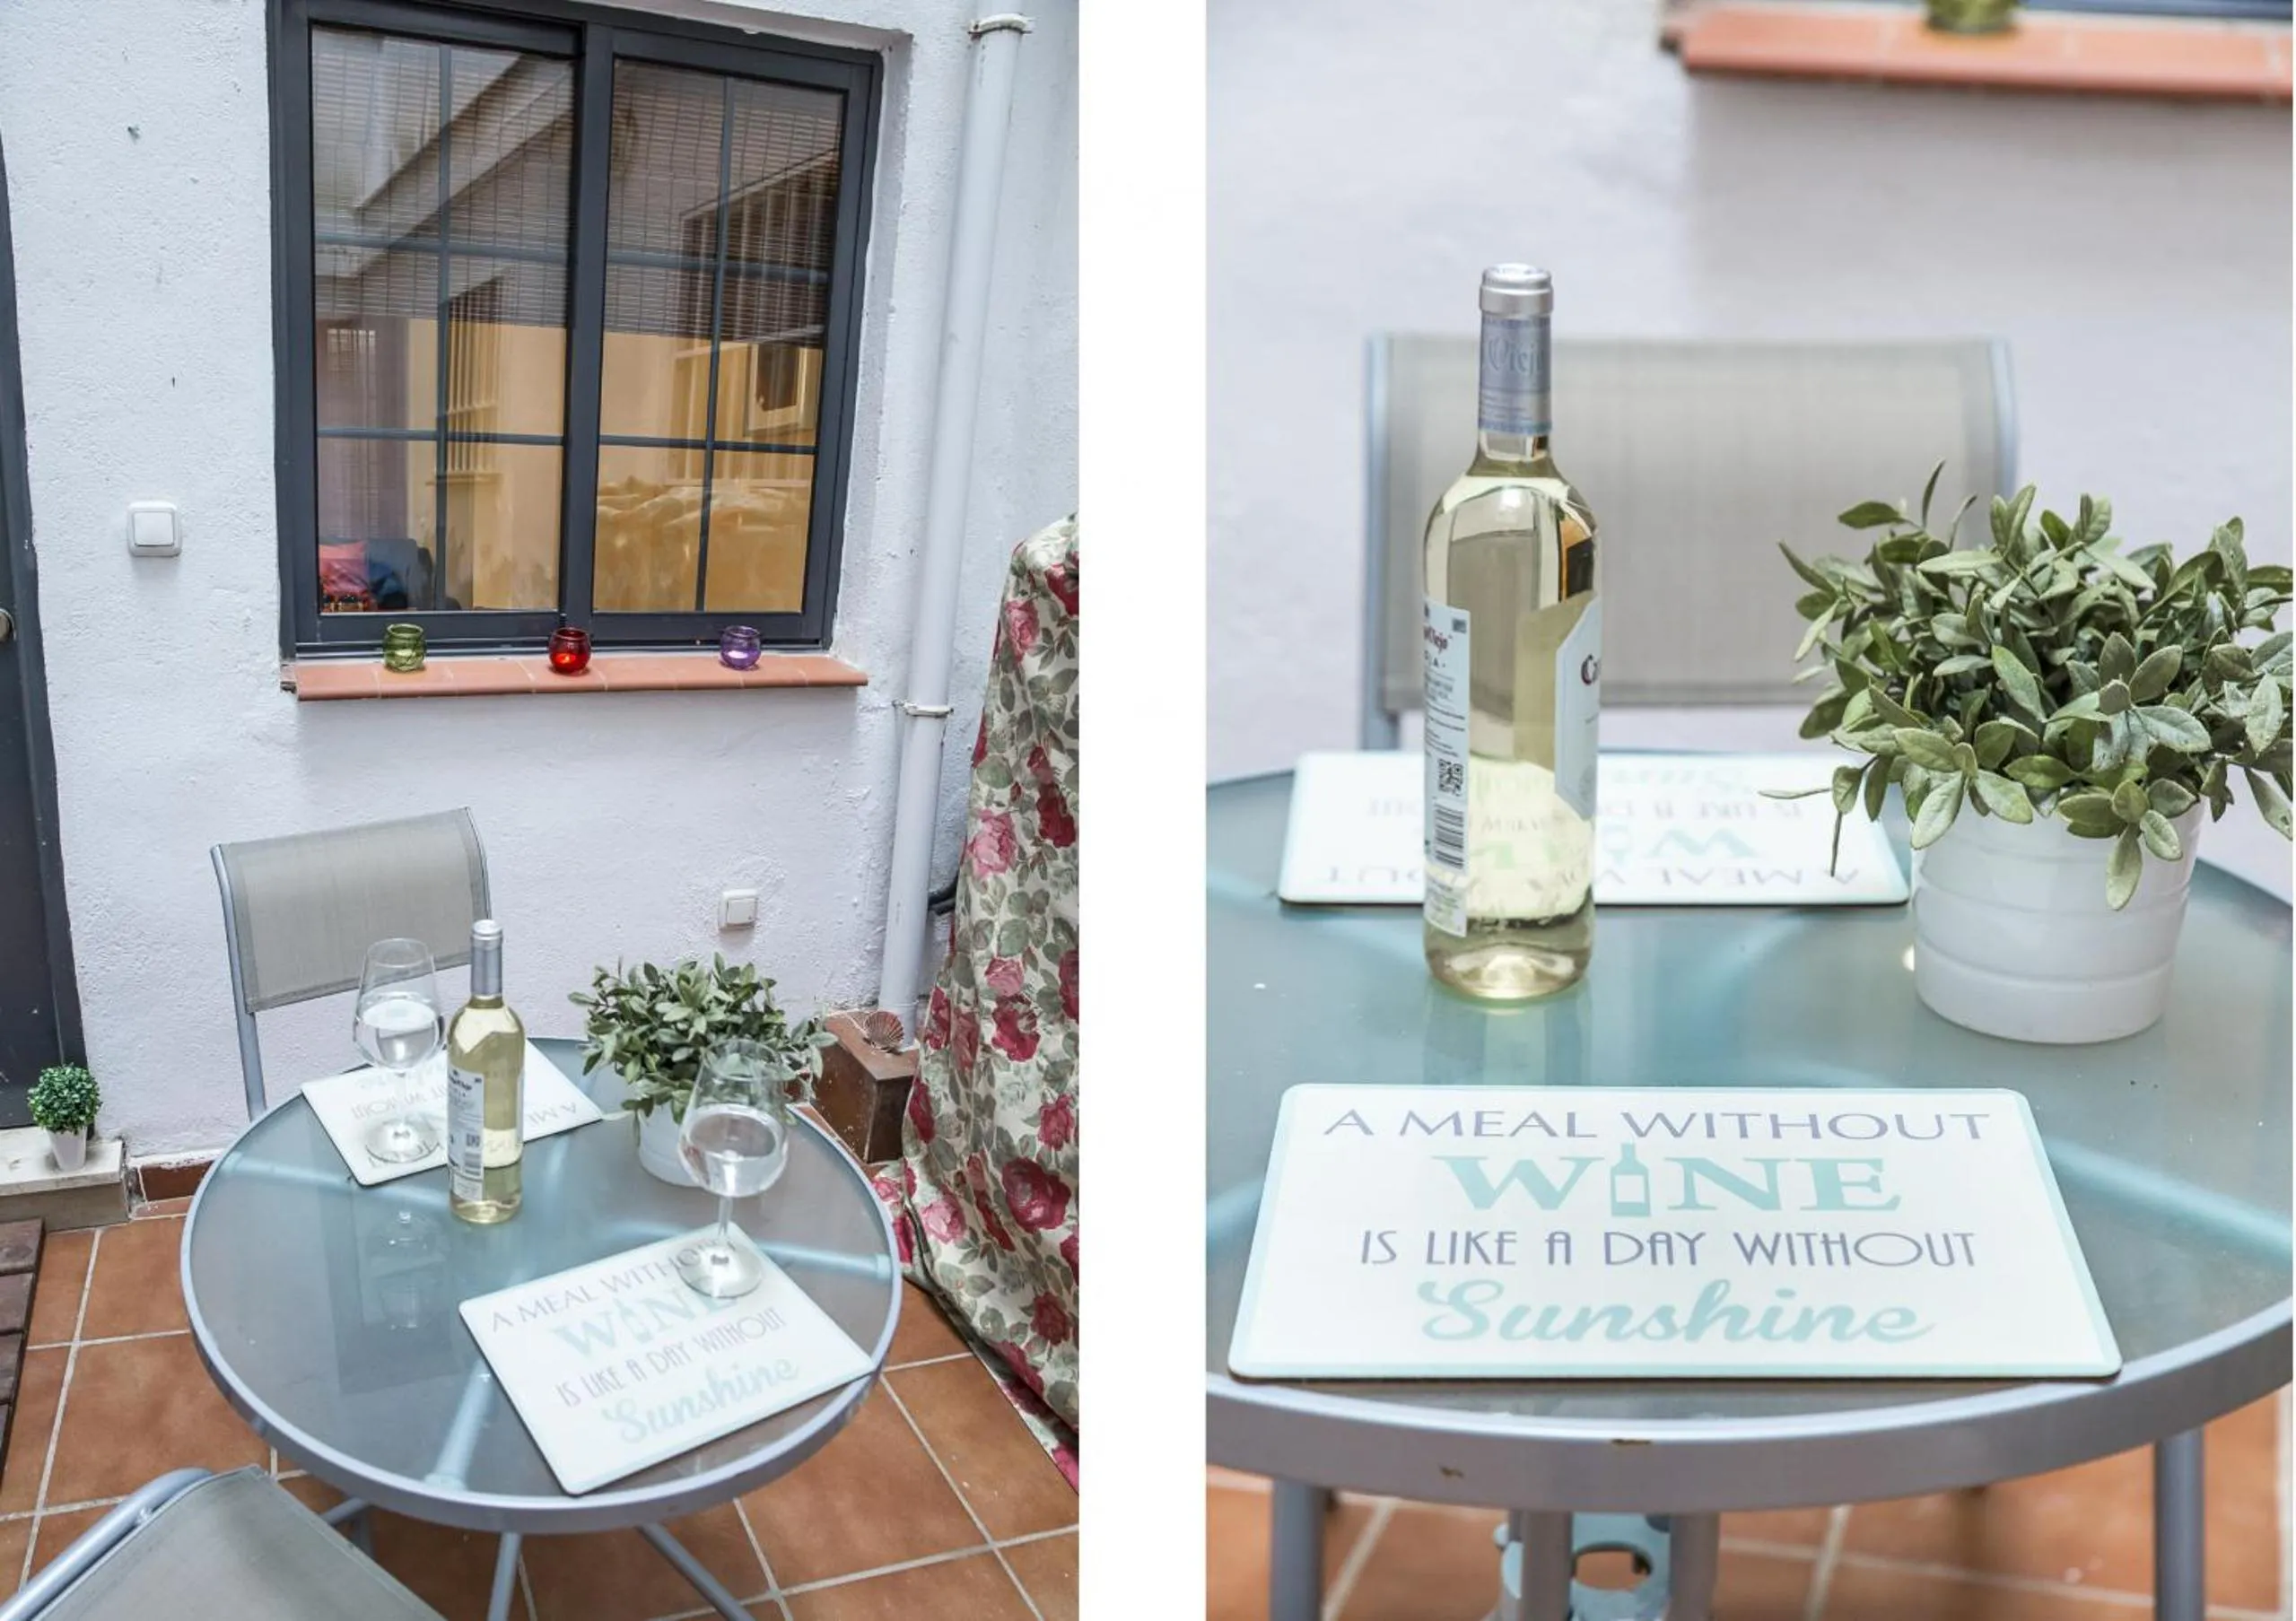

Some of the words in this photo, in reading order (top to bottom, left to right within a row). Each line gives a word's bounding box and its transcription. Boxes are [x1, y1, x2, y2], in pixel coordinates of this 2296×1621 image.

[1323, 1109, 1375, 1137] A
[1398, 1110, 1598, 1139] MEAL
[1619, 1111, 1990, 1141] WITHOUT
[1433, 1143, 1901, 1217] WINE
[1359, 1230, 1398, 1266] IS
[1425, 1230, 1519, 1267] LIKE
[1544, 1231, 1572, 1267] A
[1603, 1232, 1708, 1267] DAY
[1733, 1232, 1979, 1268] WITHOUT
[491, 1310, 514, 1334] A
[517, 1284, 598, 1325] MEAL
[1416, 1277, 1936, 1346] Sunshine
[554, 1382, 583, 1408] IS
[580, 1364, 626, 1400] LIKE
[623, 1357, 647, 1382] A
[645, 1342, 694, 1374] DAY
[694, 1307, 786, 1356] WITHOUT
[601, 1356, 801, 1446] Sunshine
